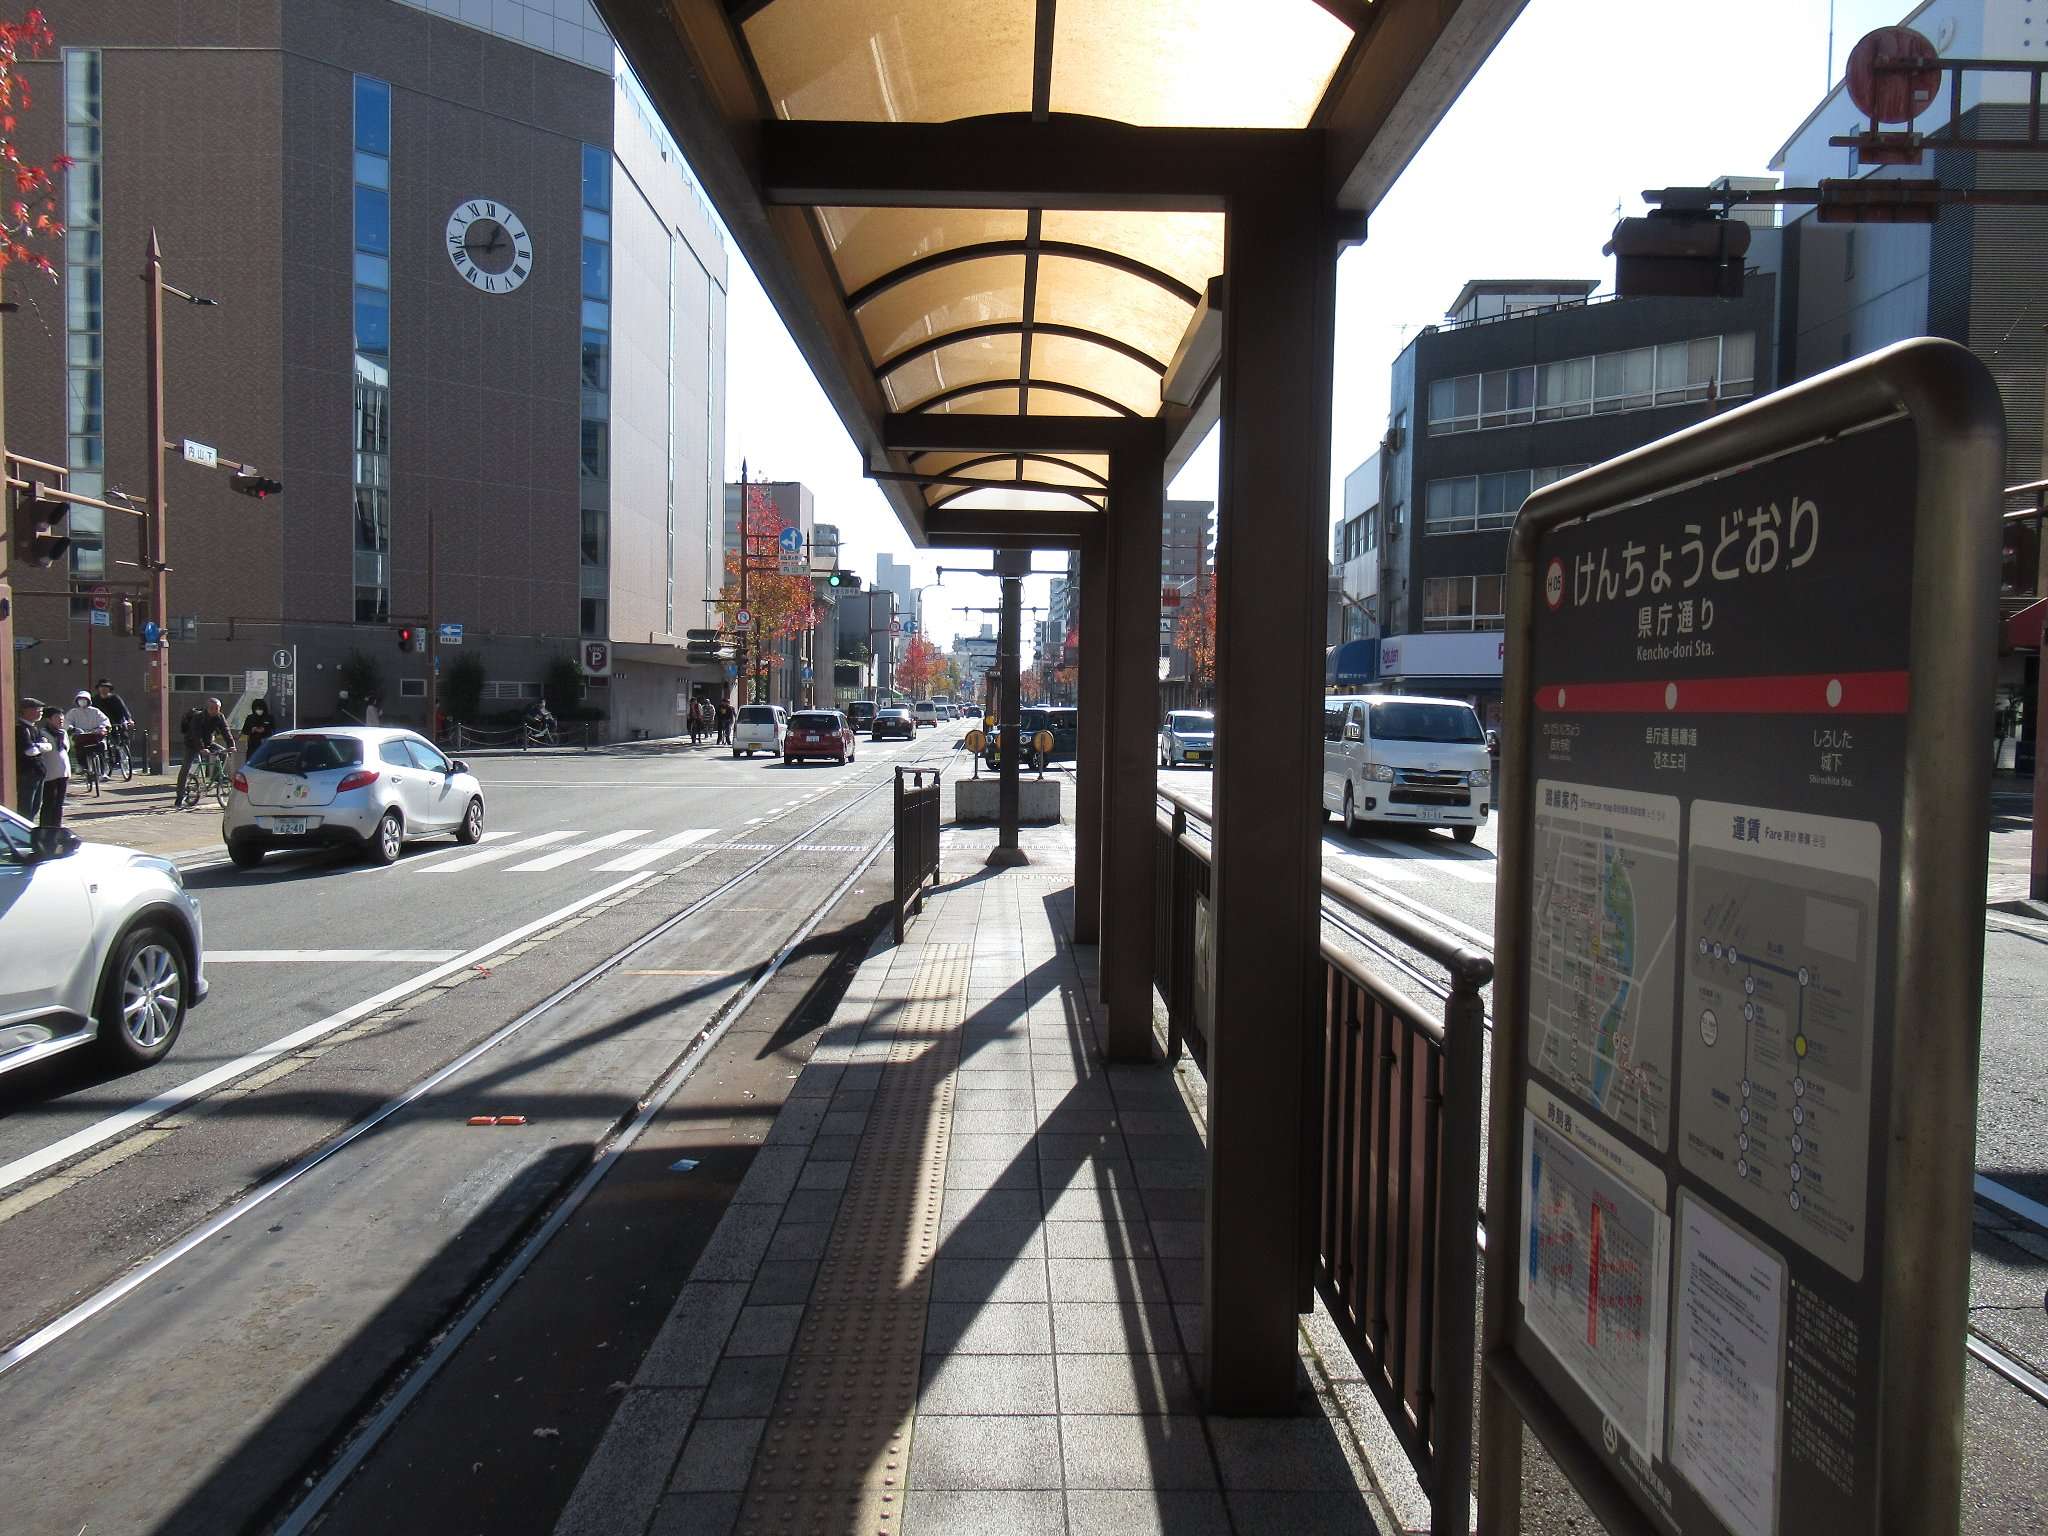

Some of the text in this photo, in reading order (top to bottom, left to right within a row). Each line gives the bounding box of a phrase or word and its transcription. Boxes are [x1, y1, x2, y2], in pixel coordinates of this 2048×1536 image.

[1573, 497, 1820, 606] けんちょうどおり
[1638, 597, 1714, 639] 県庁通り
[1636, 639, 1714, 662] Kencho-dori Sta.
[1814, 728, 1854, 749] しろした
[1820, 752, 1844, 772] 城下
[1732, 816, 1760, 844] 運賃
[1765, 826, 1782, 841] Fare
